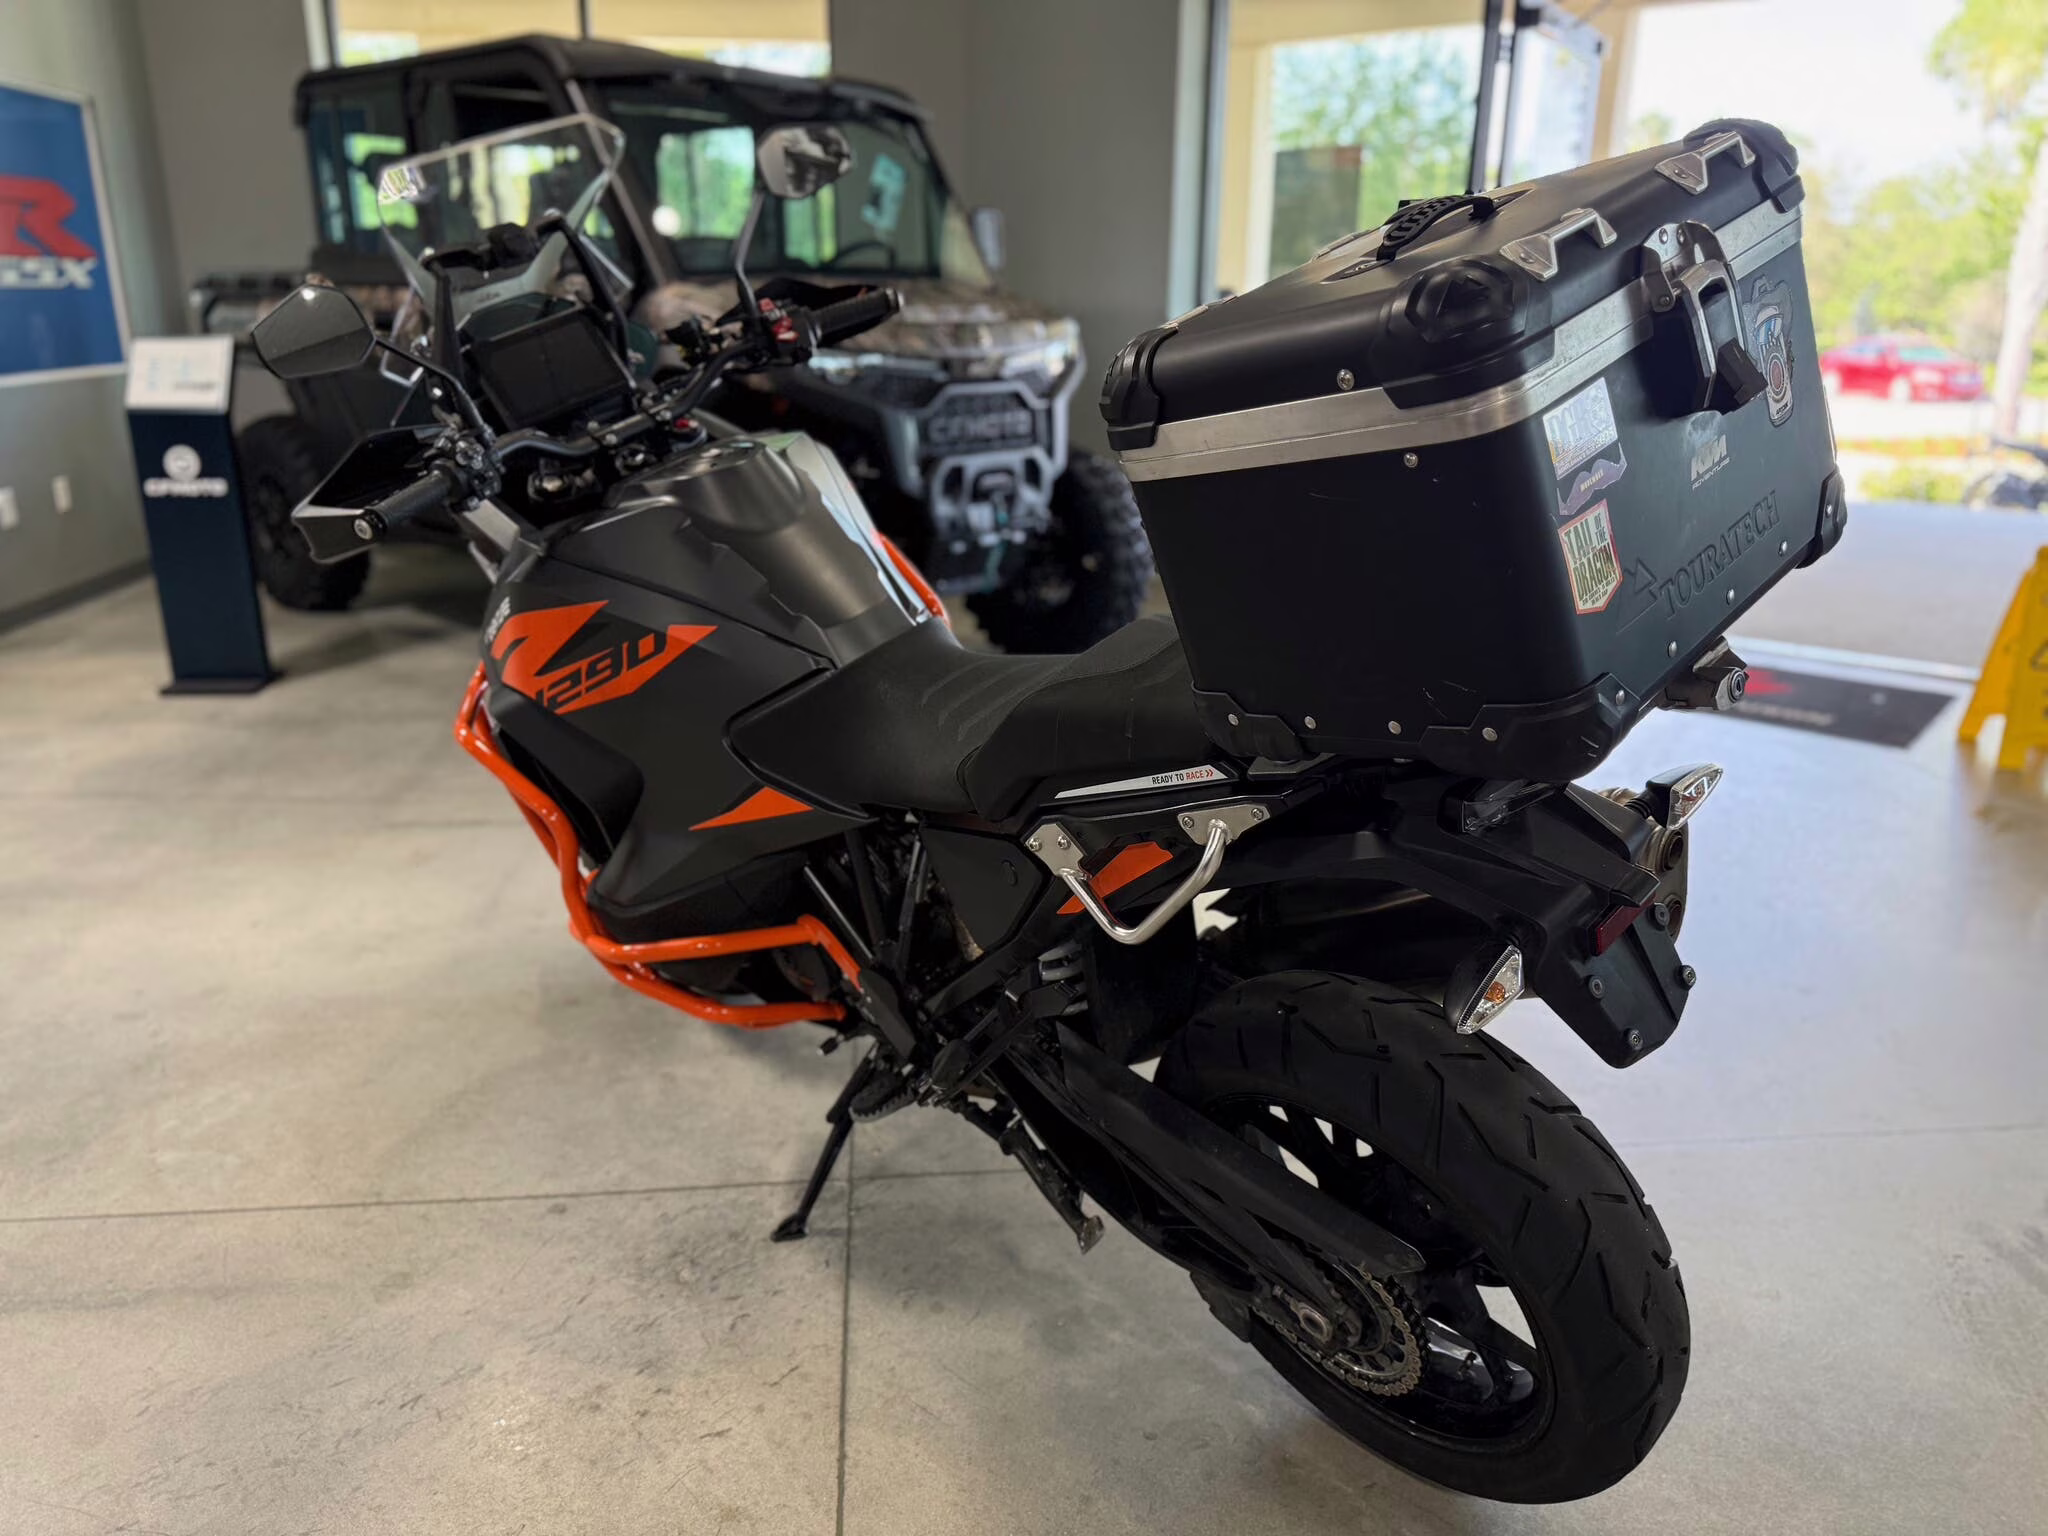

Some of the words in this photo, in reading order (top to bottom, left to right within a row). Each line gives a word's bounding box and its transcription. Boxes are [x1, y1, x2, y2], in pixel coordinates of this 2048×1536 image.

[1691, 434, 1727, 481] KTM
[1563, 518, 1594, 565] TAIL
[1595, 525, 1607, 546] THE
[1659, 489, 1781, 621] TOURATECH
[1573, 541, 1618, 601] DRAGON
[535, 630, 668, 714] 1290
[1151, 774, 1174, 785] READY
[1175, 773, 1184, 782] TO
[1185, 770, 1204, 781] RACE
